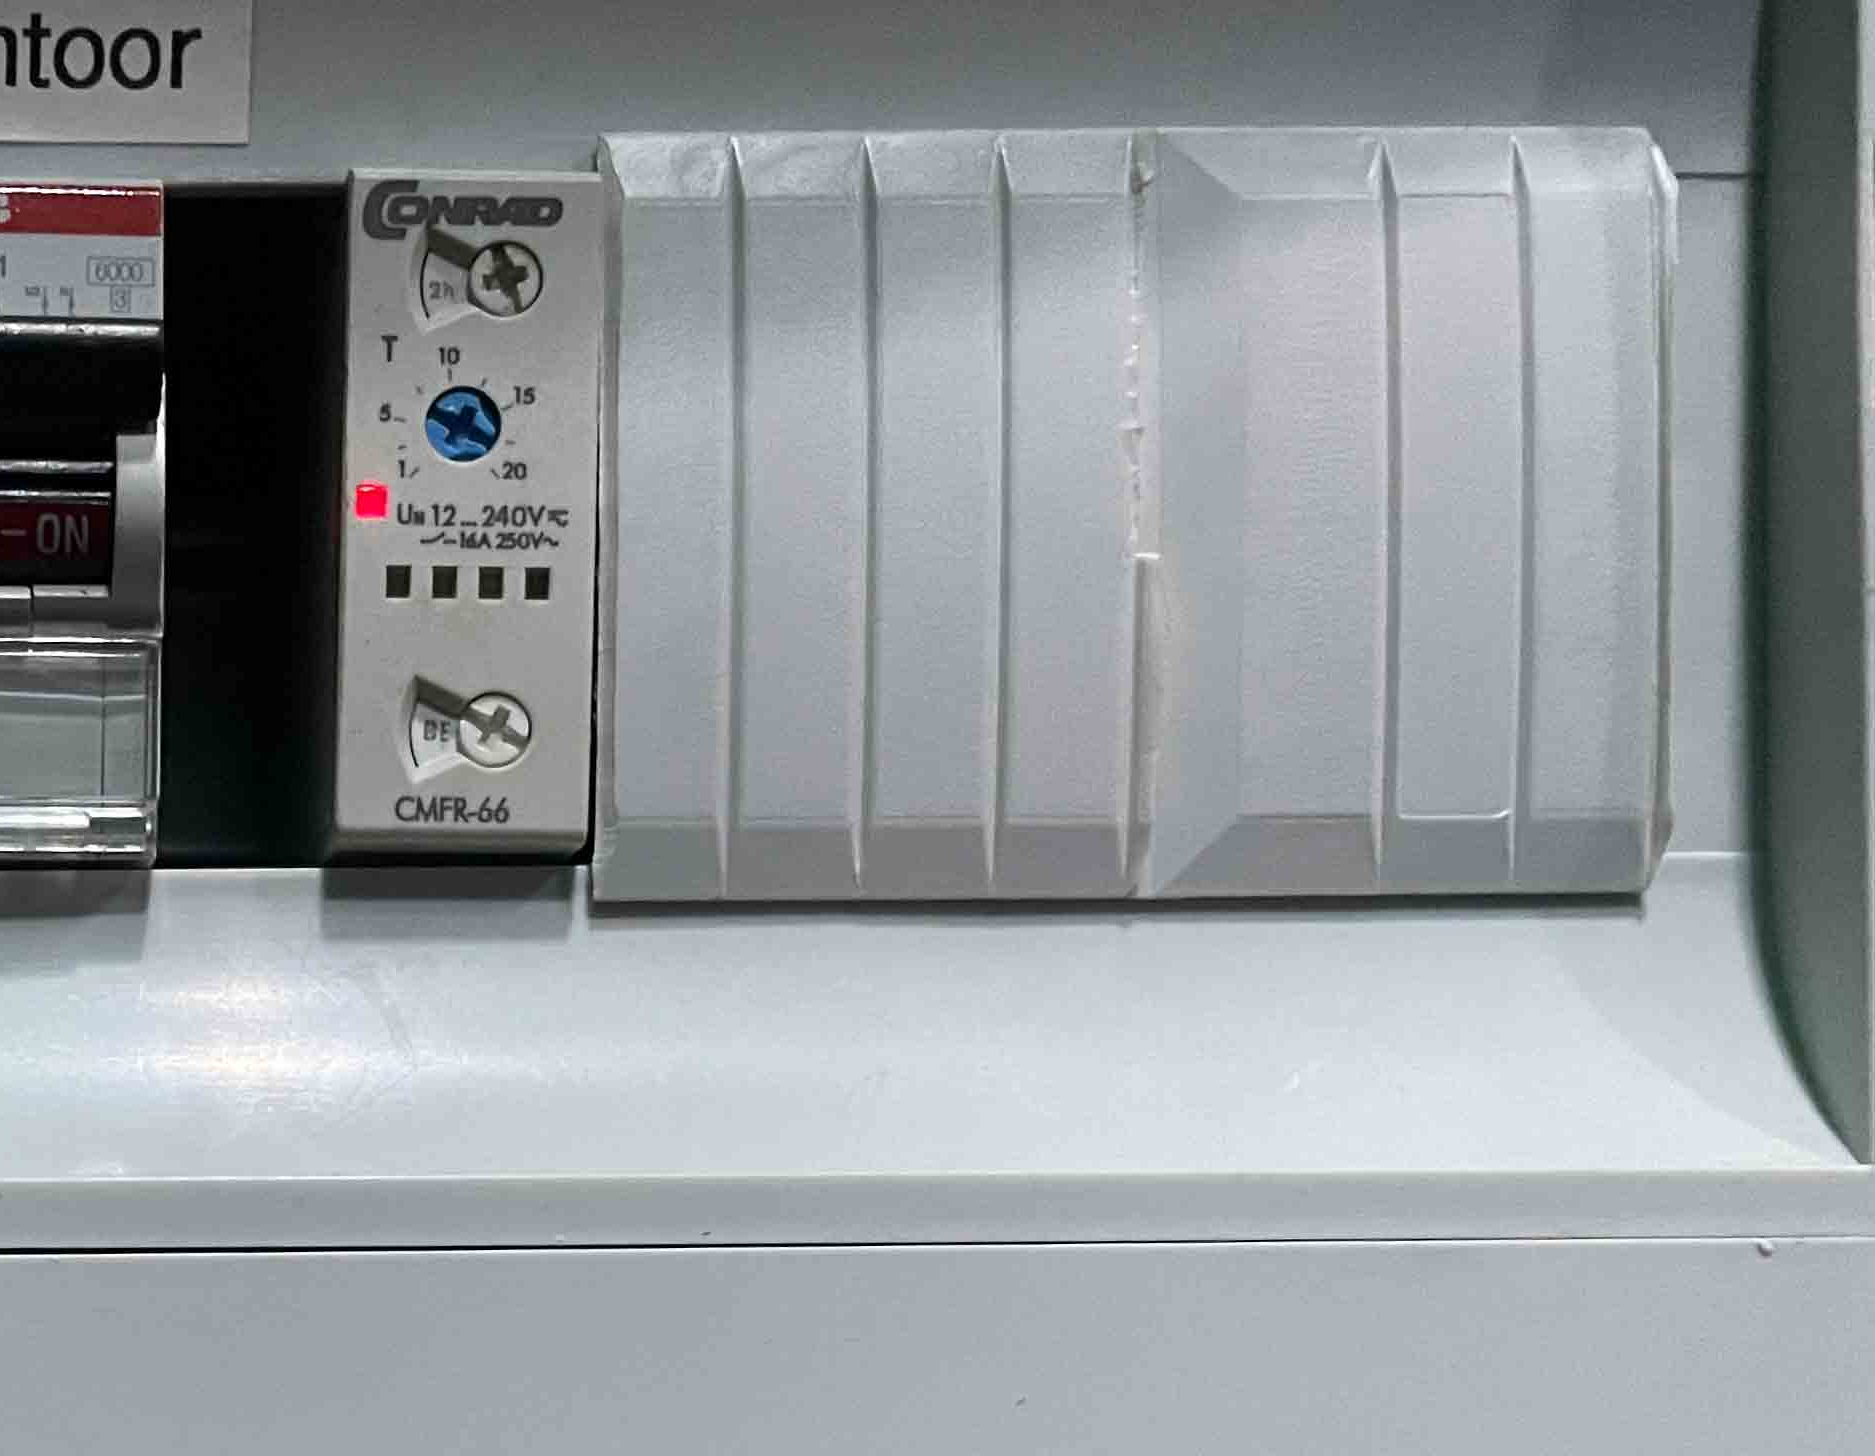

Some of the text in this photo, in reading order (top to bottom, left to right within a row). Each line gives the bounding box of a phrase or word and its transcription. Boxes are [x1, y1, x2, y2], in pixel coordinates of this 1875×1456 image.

[363, 180, 564, 240] CONRAD
[382, 335, 399, 362] T
[439, 347, 460, 365] 10
[513, 387, 535, 405] 15
[379, 404, 392, 422] 5
[502, 462, 527, 479] 20
[395, 796, 510, 823] CMFR-66
